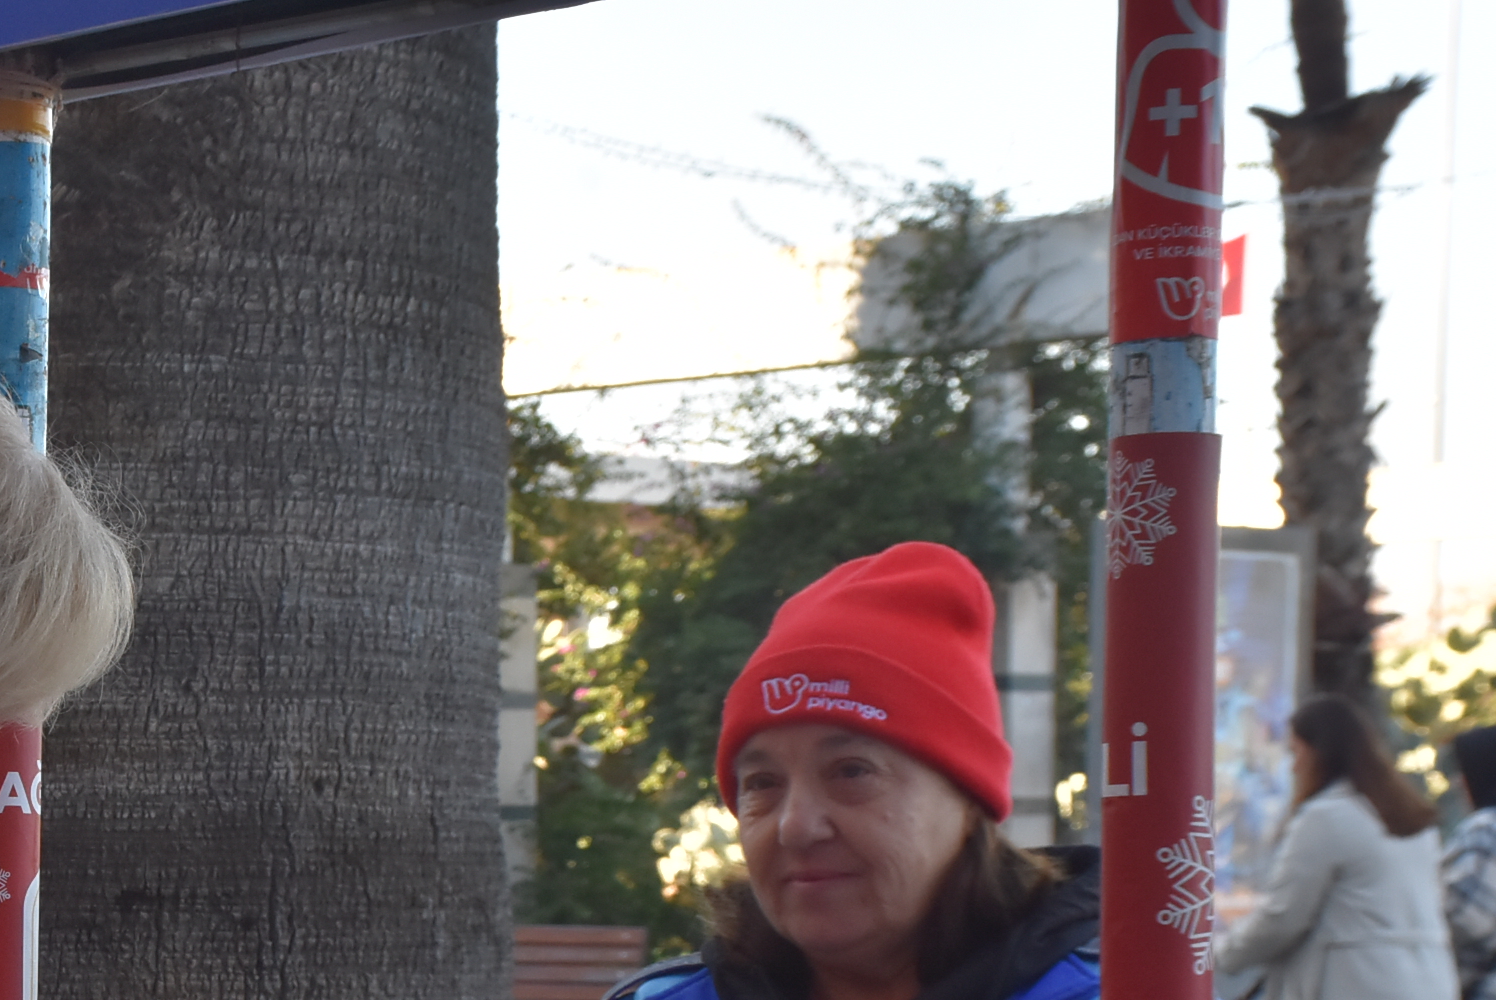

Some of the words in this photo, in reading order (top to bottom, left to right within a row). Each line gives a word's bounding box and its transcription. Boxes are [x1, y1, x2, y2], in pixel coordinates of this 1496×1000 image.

[1133, 247, 1154, 260] VE
[808, 679, 850, 695] milli
[806, 693, 887, 720] piyango
